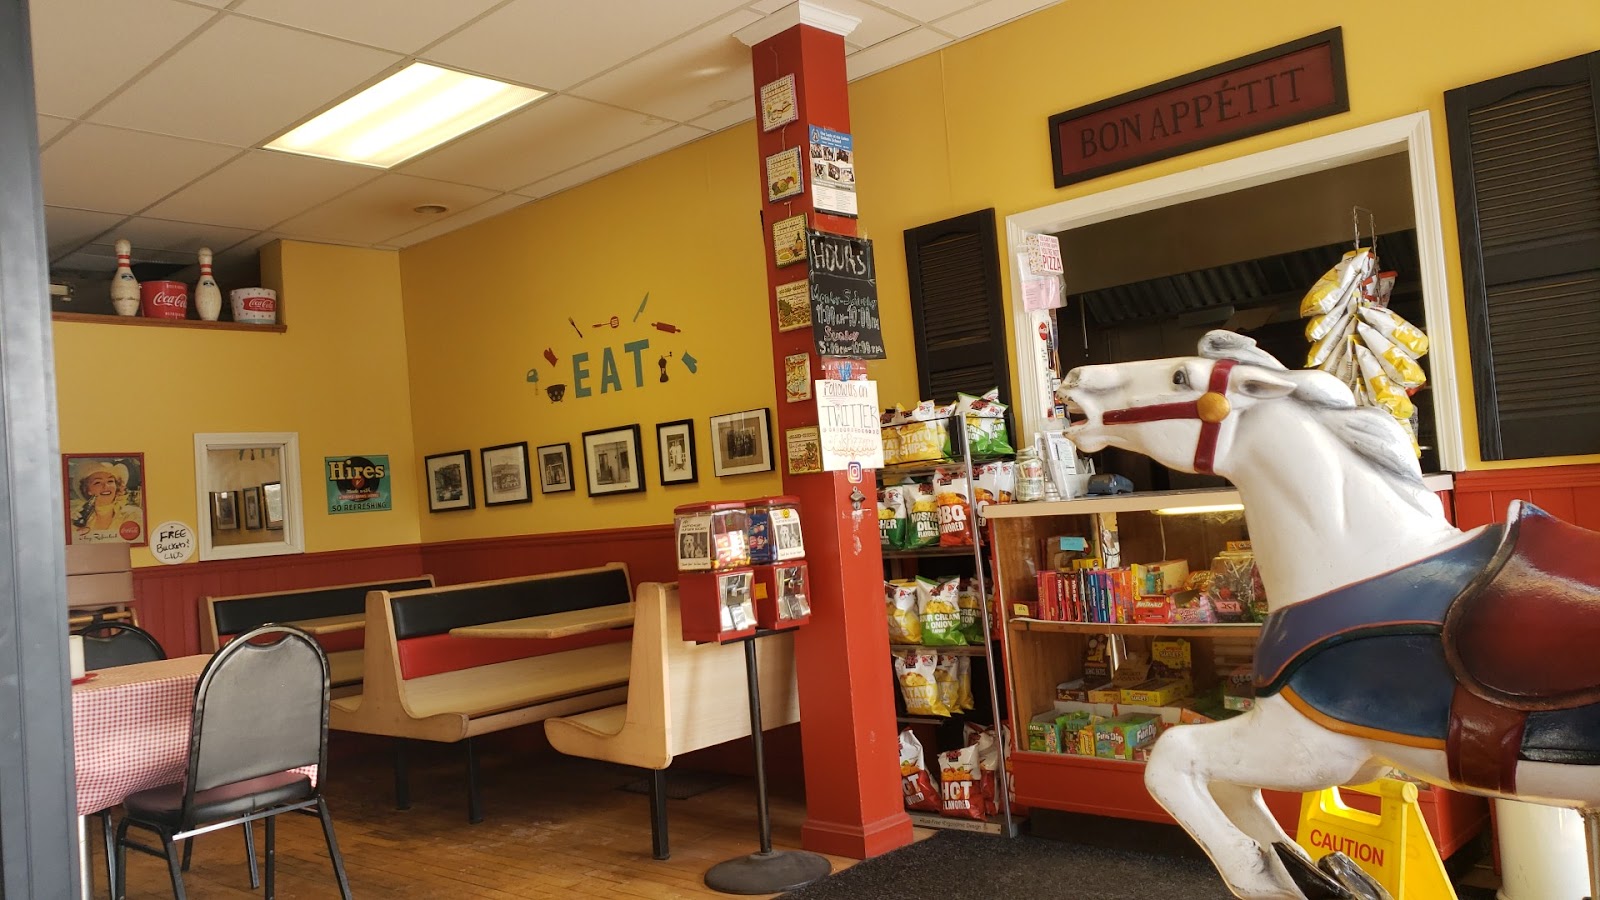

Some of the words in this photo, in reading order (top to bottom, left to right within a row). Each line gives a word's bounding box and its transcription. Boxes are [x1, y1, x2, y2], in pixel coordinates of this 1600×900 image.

[1080, 113, 1143, 159] BON
[1149, 67, 1305, 141] APPÉTIT
[811, 239, 867, 275] HOURS
[1042, 255, 1062, 271] PIZZA
[572, 339, 650, 398] EAT
[820, 403, 880, 429] TWITTER
[328, 459, 386, 481] Hires
[332, 504, 342, 512] SO
[343, 501, 387, 512] REFRESHING
[160, 528, 187, 543] FREE
[1097, 732, 1110, 741] Fun
[1110, 732, 1124, 743] Dip
[941, 780, 973, 801] HOT
[1310, 829, 1385, 867] CAUTION
